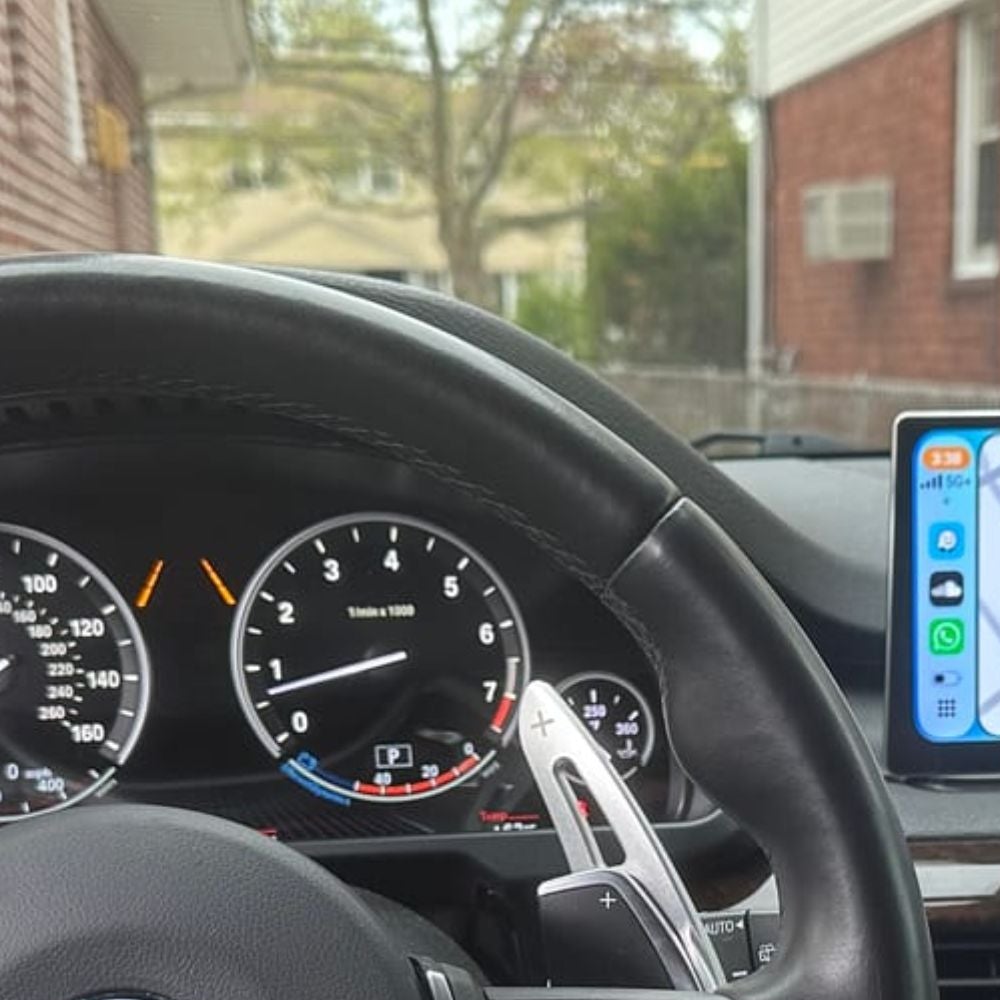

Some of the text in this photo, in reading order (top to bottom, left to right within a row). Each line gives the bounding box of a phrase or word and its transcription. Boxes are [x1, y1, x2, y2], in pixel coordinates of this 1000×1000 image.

[323, 559, 340, 582] 3
[383, 549, 400, 572] 4
[21, 573, 58, 593] 100
[443, 575, 460, 598] 5
[278, 601, 295, 625] 2
[69, 618, 105, 637] 120
[478, 622, 495, 645] 6
[40, 642, 67, 656] 200
[47, 662, 74, 677] 220
[86, 670, 120, 689] 140
[269, 658, 282, 681] 1
[482, 680, 497, 702] 7
[291, 711, 309, 733] 0
[71, 724, 105, 742] 160
[386, 750, 400, 766] P
[6, 763, 20, 780] 0
